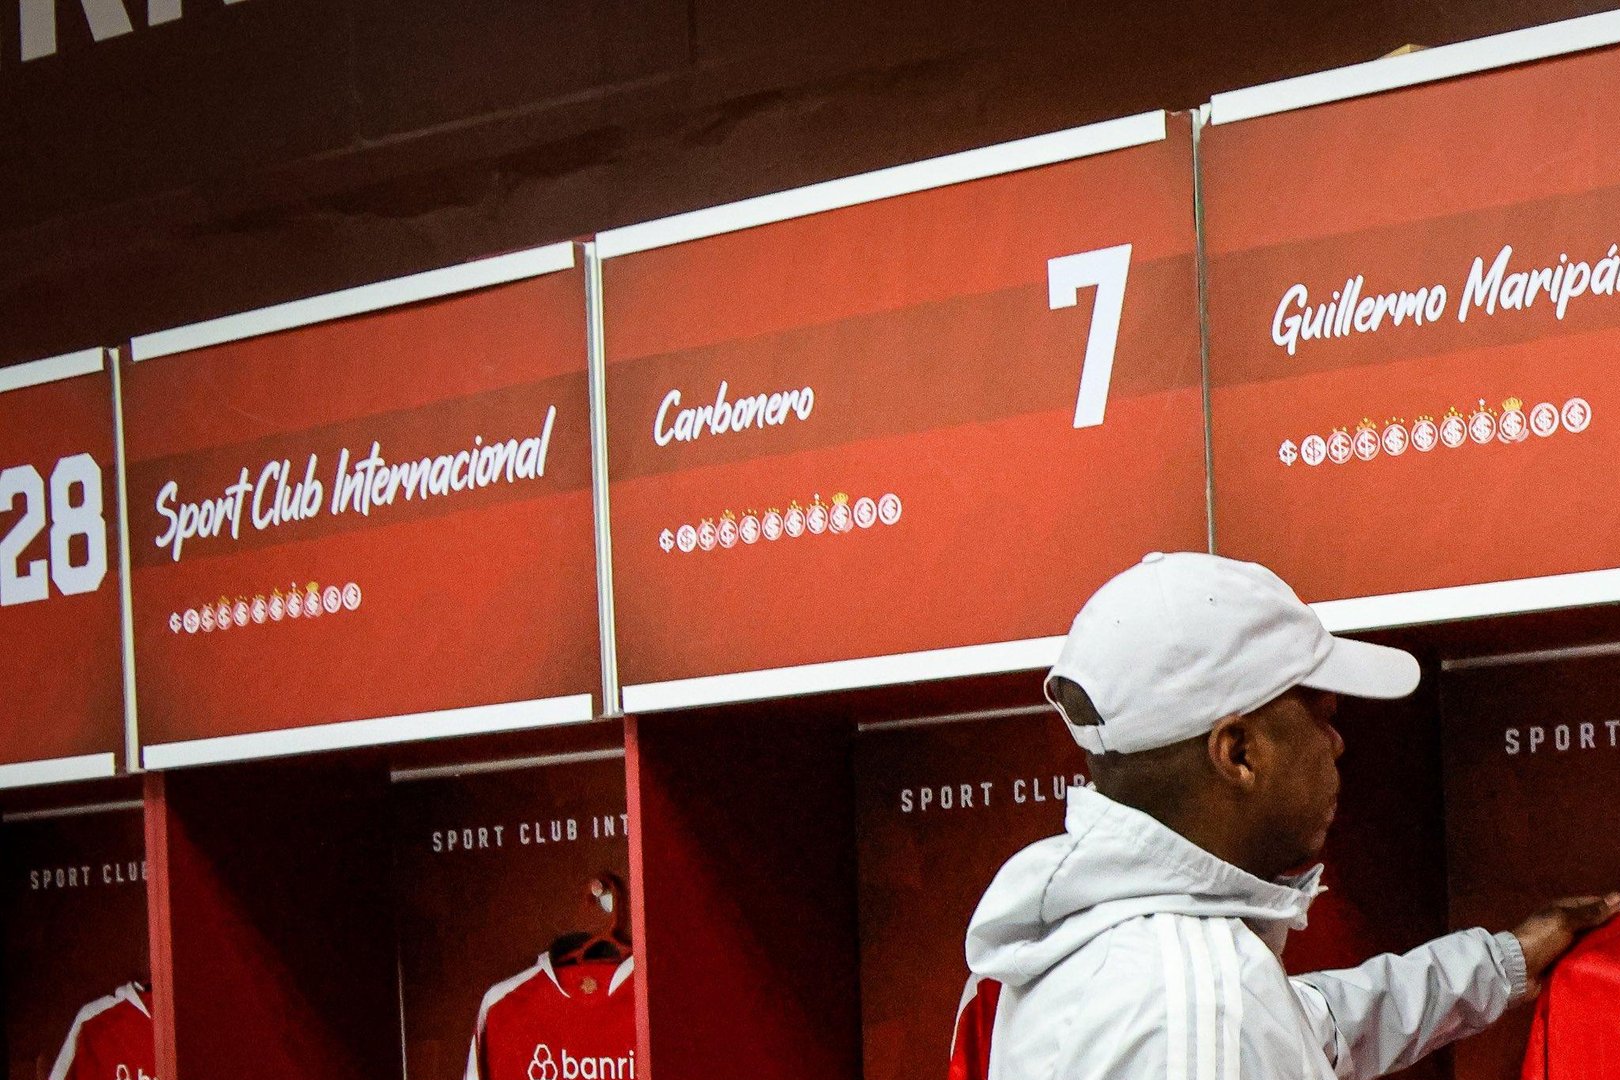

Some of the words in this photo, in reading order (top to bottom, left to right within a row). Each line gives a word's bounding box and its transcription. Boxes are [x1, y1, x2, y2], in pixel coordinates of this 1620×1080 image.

[1046, 243, 1133, 429] 7
[1271, 274, 1447, 356] Guillermo
[653, 380, 815, 447] Carbonero
[154, 465, 254, 562] Sport
[251, 452, 323, 531] Club
[330, 404, 557, 517] Internacional
[0, 452, 108, 607] 28
[1505, 720, 1620, 755] SPORT
[901, 782, 993, 813] SPORT
[432, 825, 504, 852] SPORT
[519, 818, 578, 845] CLUB
[593, 812, 629, 839] INT
[30, 865, 91, 890] SPORT
[561, 1049, 635, 1080] banri
